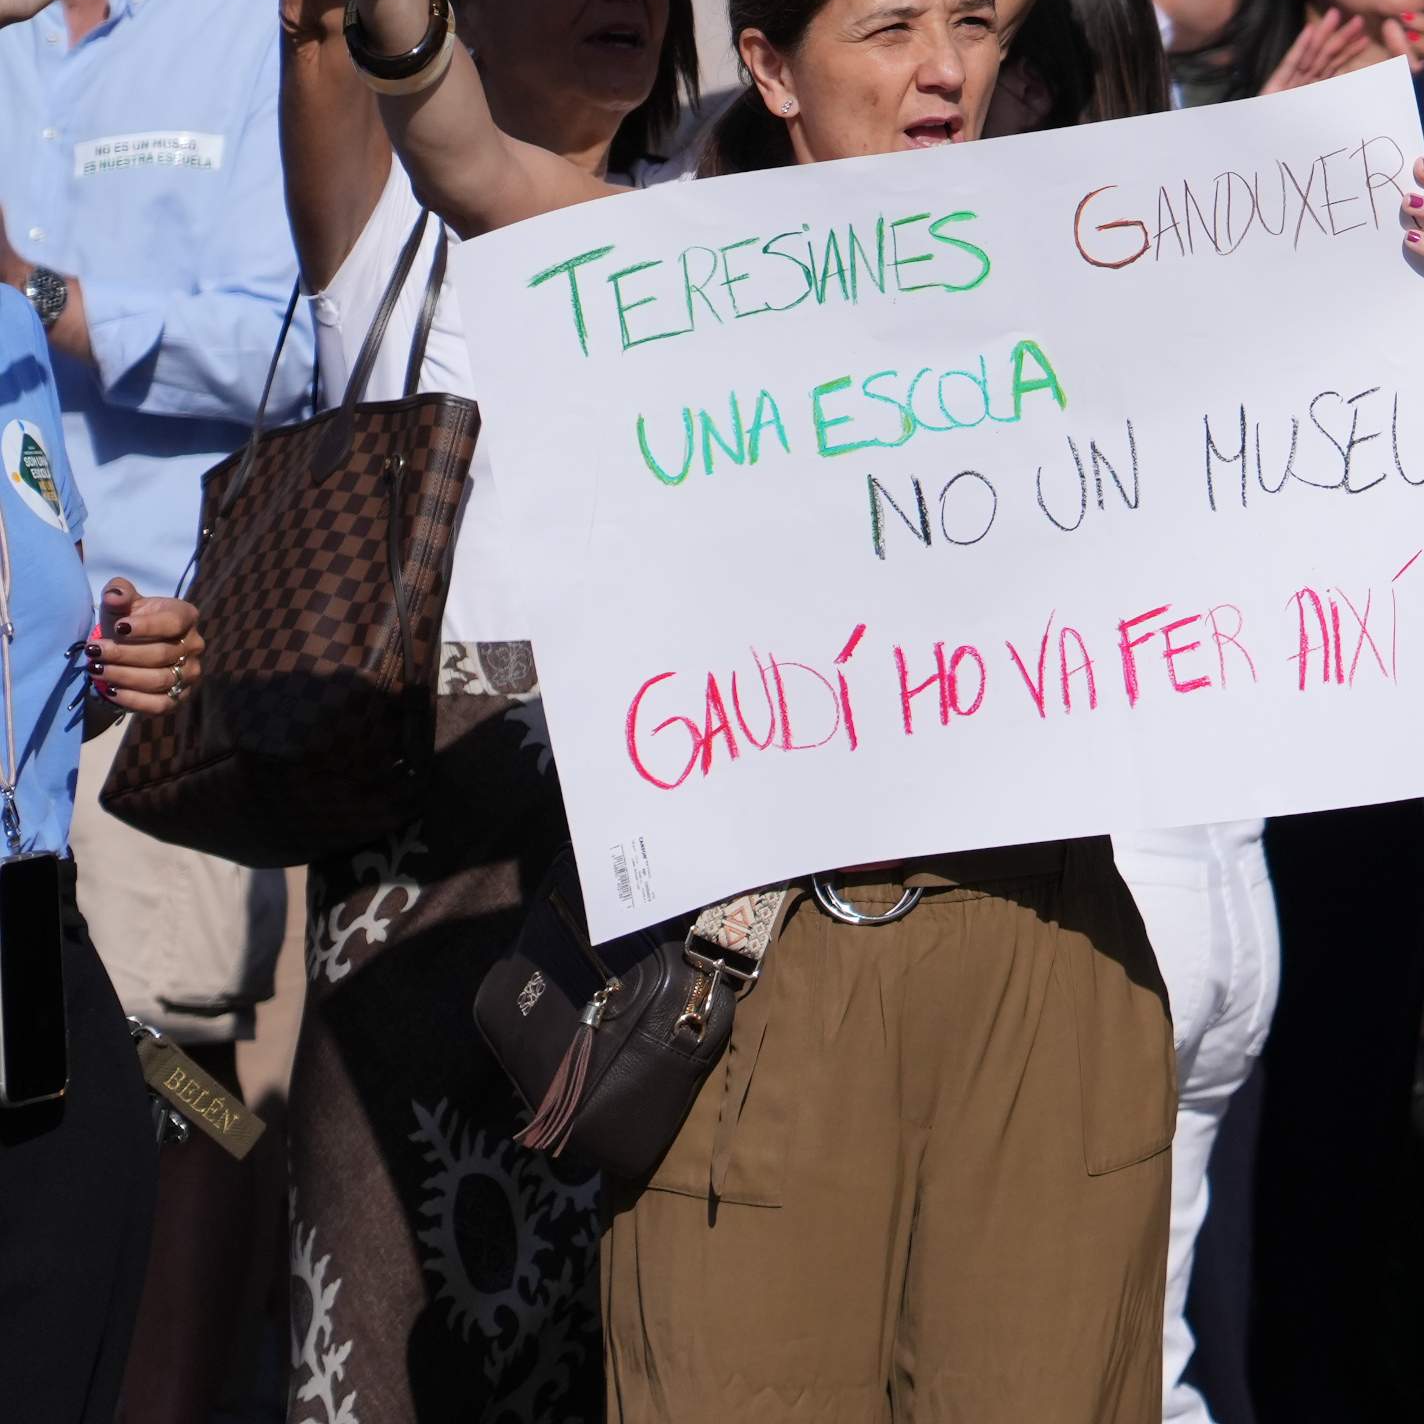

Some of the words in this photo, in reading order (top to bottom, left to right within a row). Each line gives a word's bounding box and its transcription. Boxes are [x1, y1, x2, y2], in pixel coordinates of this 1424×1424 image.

[99, 154, 153, 169] NUESTRA
[1074, 136, 1421, 270] GANDUXER
[636, 390, 791, 486] UNA
[867, 471, 997, 560] NO
[1036, 419, 1139, 531] UN
[625, 623, 868, 791] GAUDÍ
[893, 641, 987, 736] HO
[1005, 610, 1096, 720] VA
[1116, 604, 1256, 709] FER
[163, 1066, 239, 1135] BELÉN
